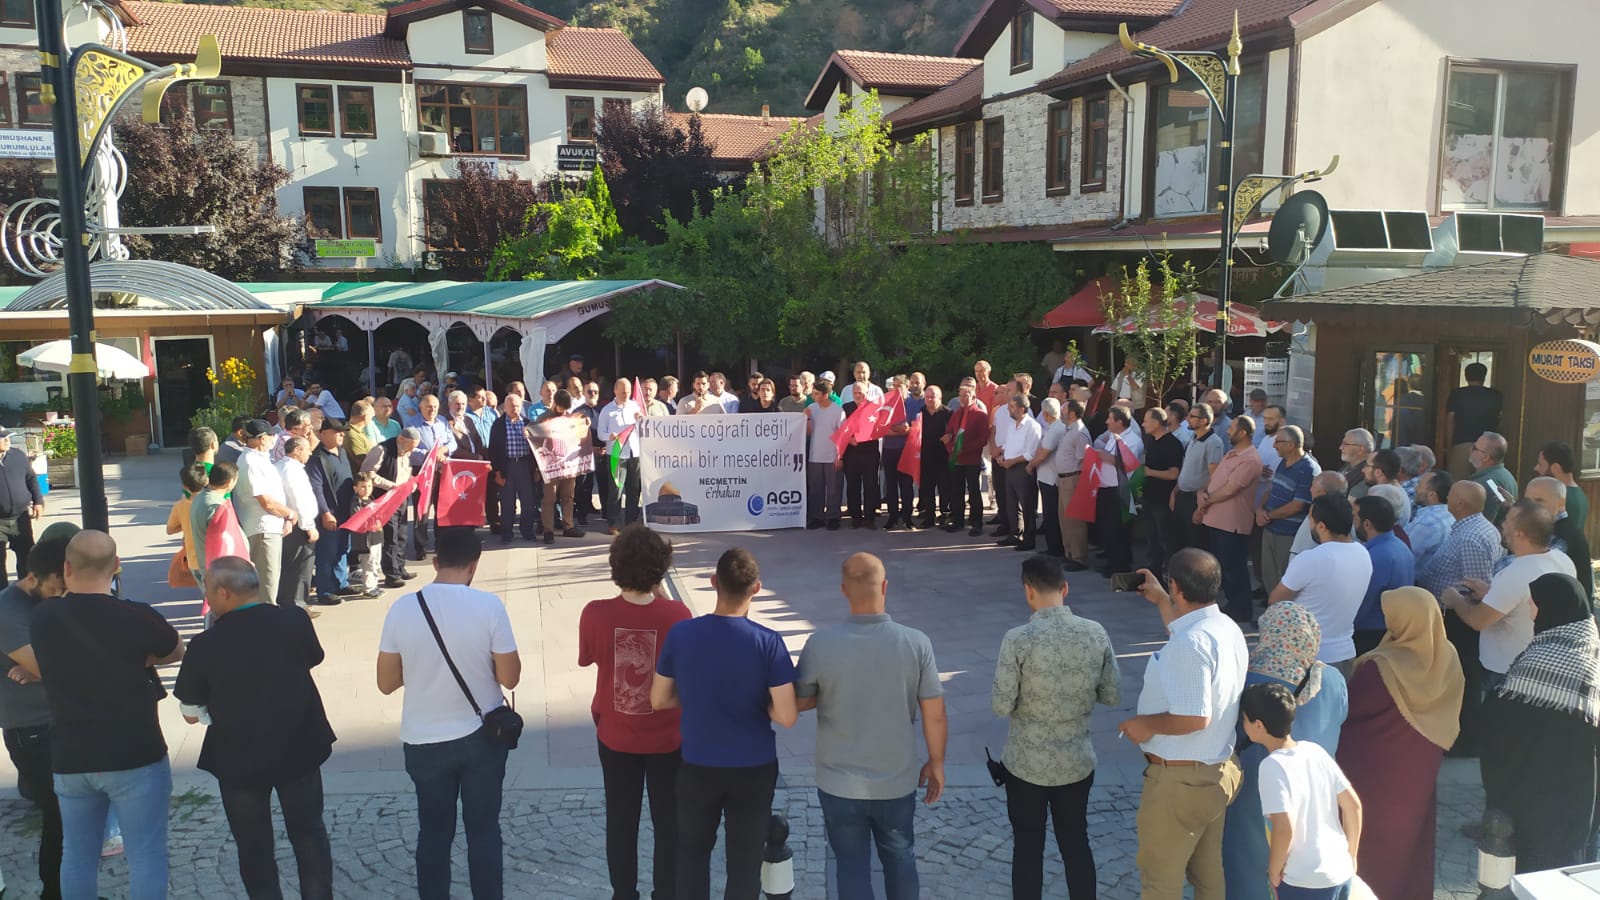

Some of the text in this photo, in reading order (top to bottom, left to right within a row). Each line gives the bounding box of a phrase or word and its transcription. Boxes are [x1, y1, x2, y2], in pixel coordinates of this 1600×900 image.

[560, 148, 595, 156] AVUKAT
[1532, 353, 1563, 367] MURAT
[700, 418, 749, 442] coğrafi
[755, 418, 792, 441] değil,
[653, 450, 693, 468] imani
[698, 450, 719, 468] bir
[699, 476, 748, 486] NECMETTİN
[705, 484, 741, 499] Erbakan
[767, 490, 802, 505] AGD
